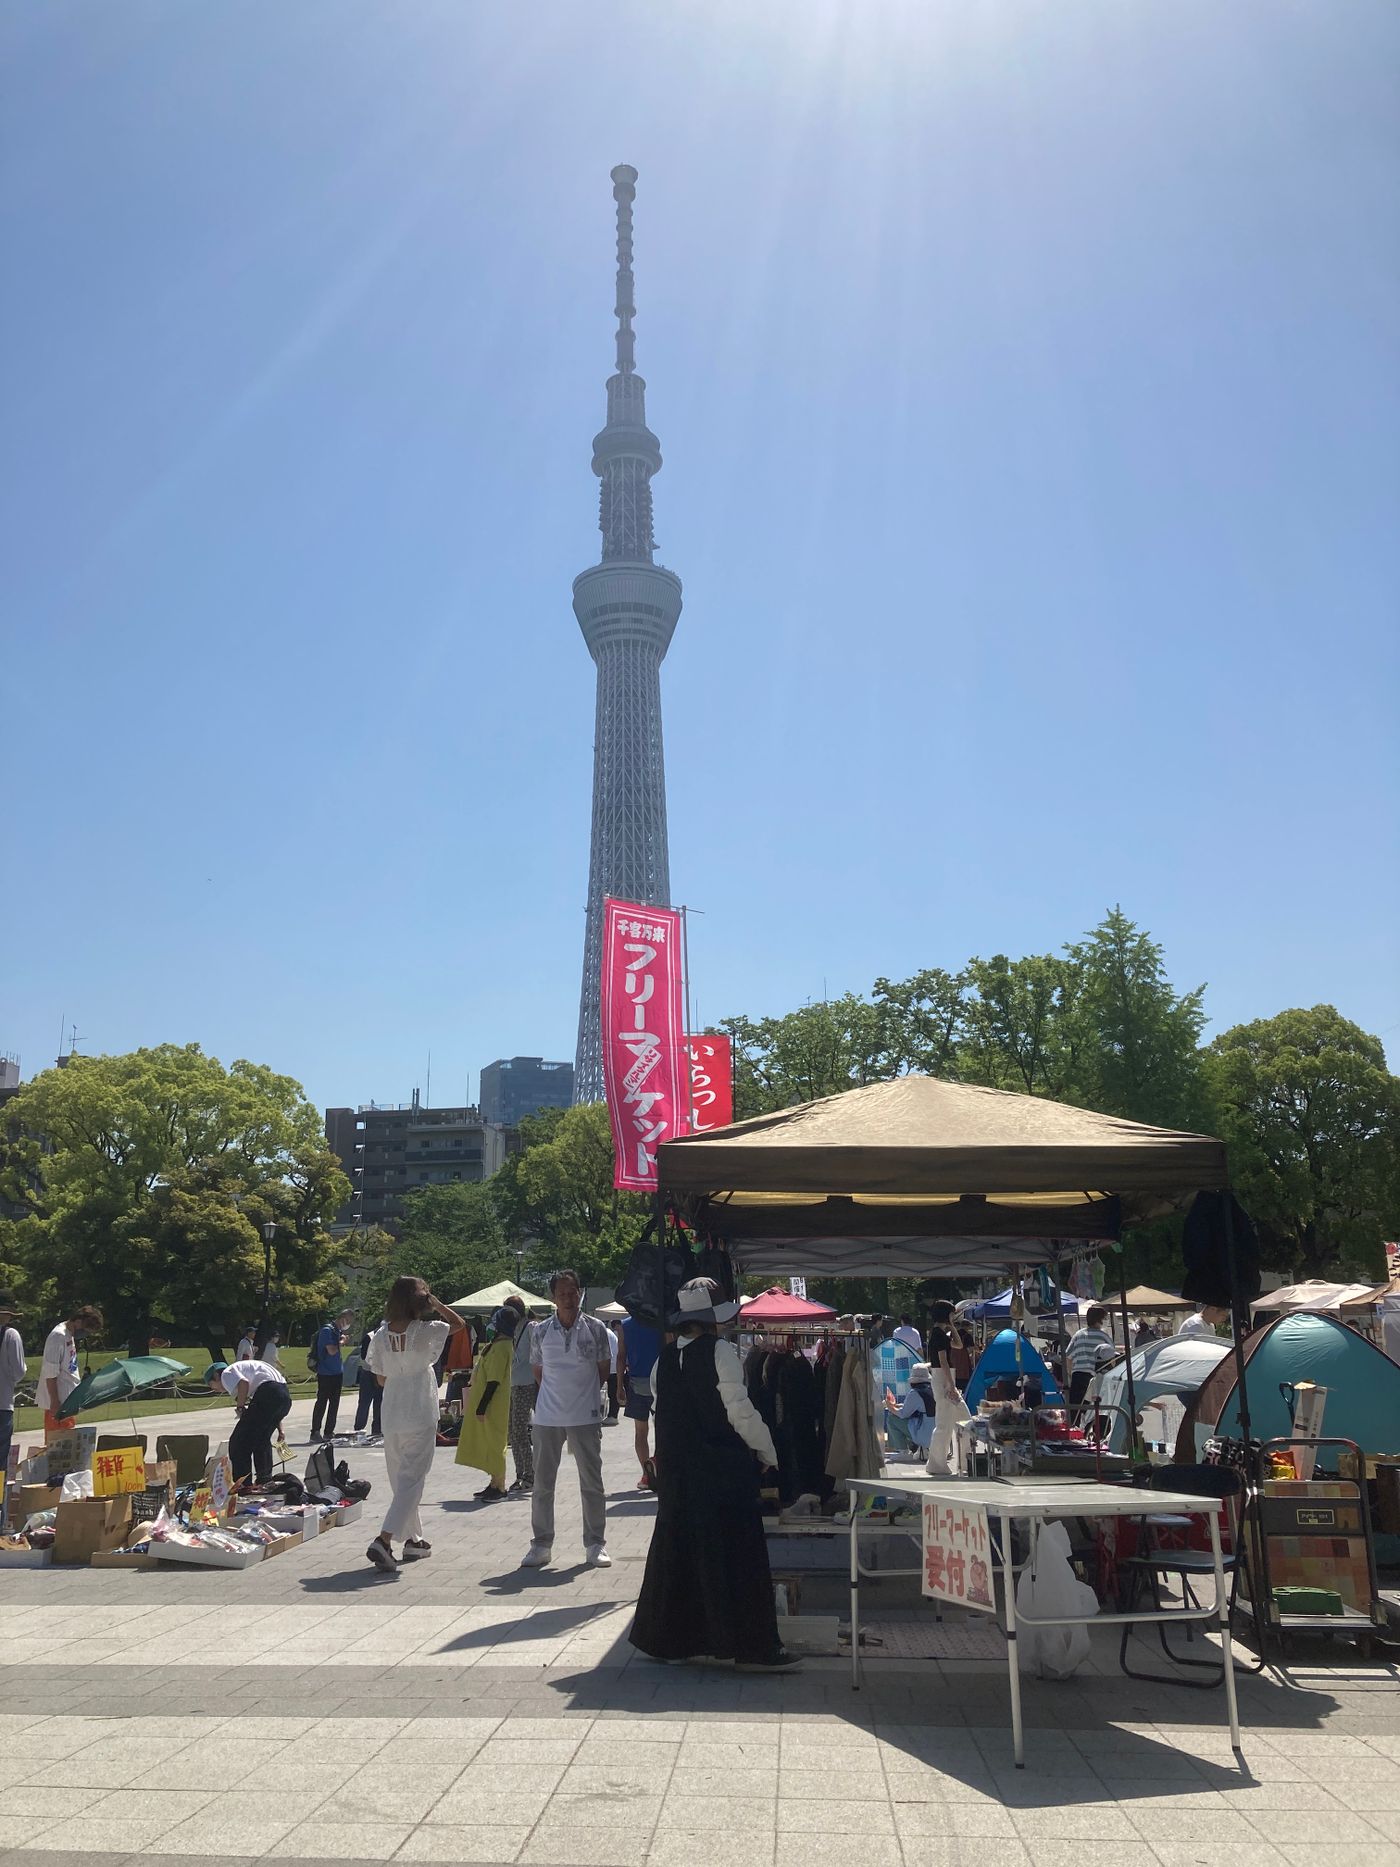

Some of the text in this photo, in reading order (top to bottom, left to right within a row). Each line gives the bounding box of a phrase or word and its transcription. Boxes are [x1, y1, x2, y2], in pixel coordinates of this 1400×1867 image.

[618, 943, 668, 1176] フリーマケット
[924, 1504, 986, 1552] フリーマーケット
[925, 1545, 966, 1597] 受付
